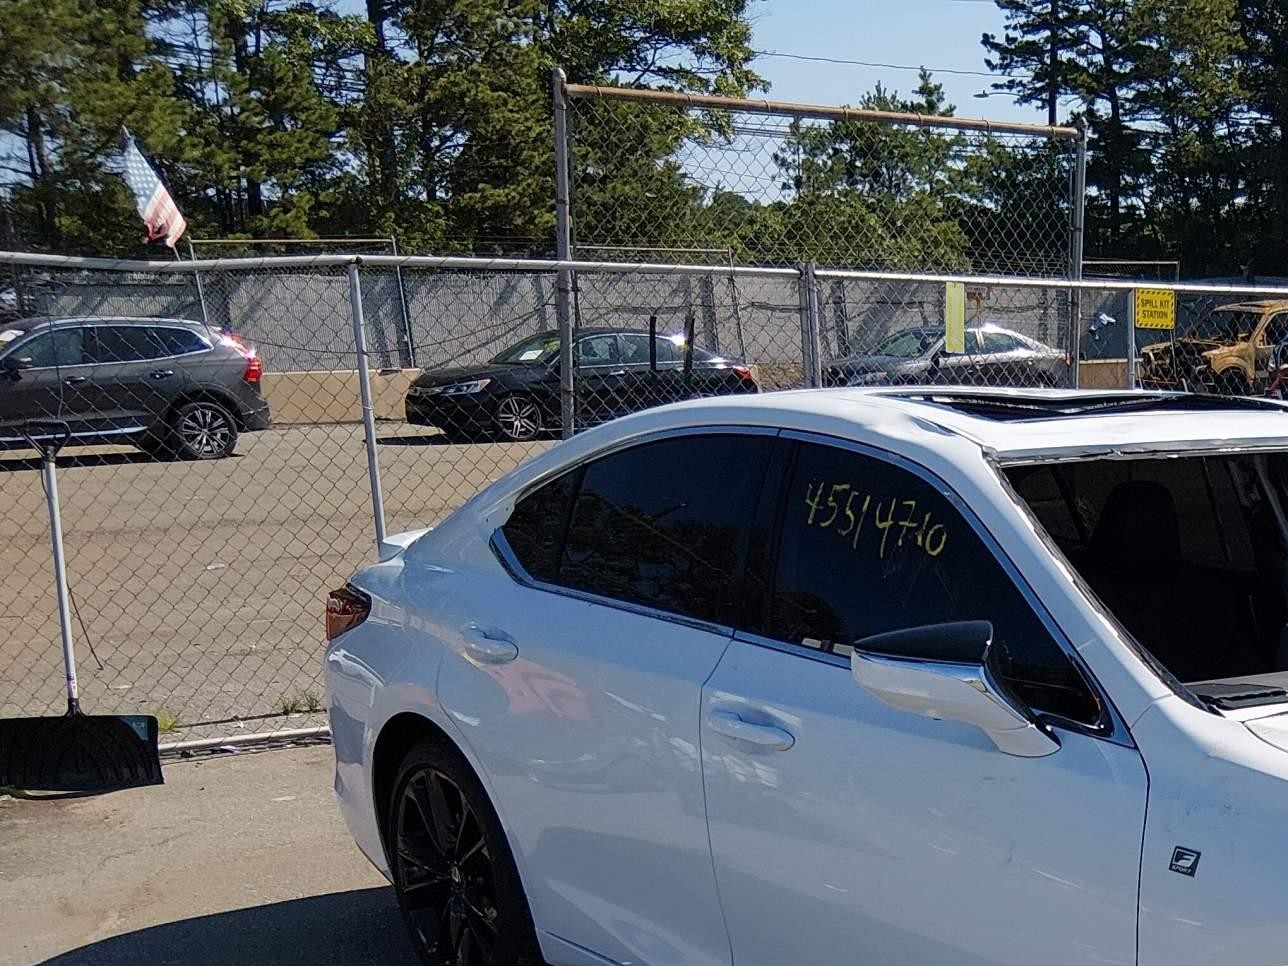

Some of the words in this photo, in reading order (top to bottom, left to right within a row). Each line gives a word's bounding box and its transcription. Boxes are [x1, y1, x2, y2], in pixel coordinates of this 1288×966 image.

[1140, 299, 1159, 309] SPILL
[1142, 309, 1169, 320] STATION
[805, 482, 947, 560] 45514710
